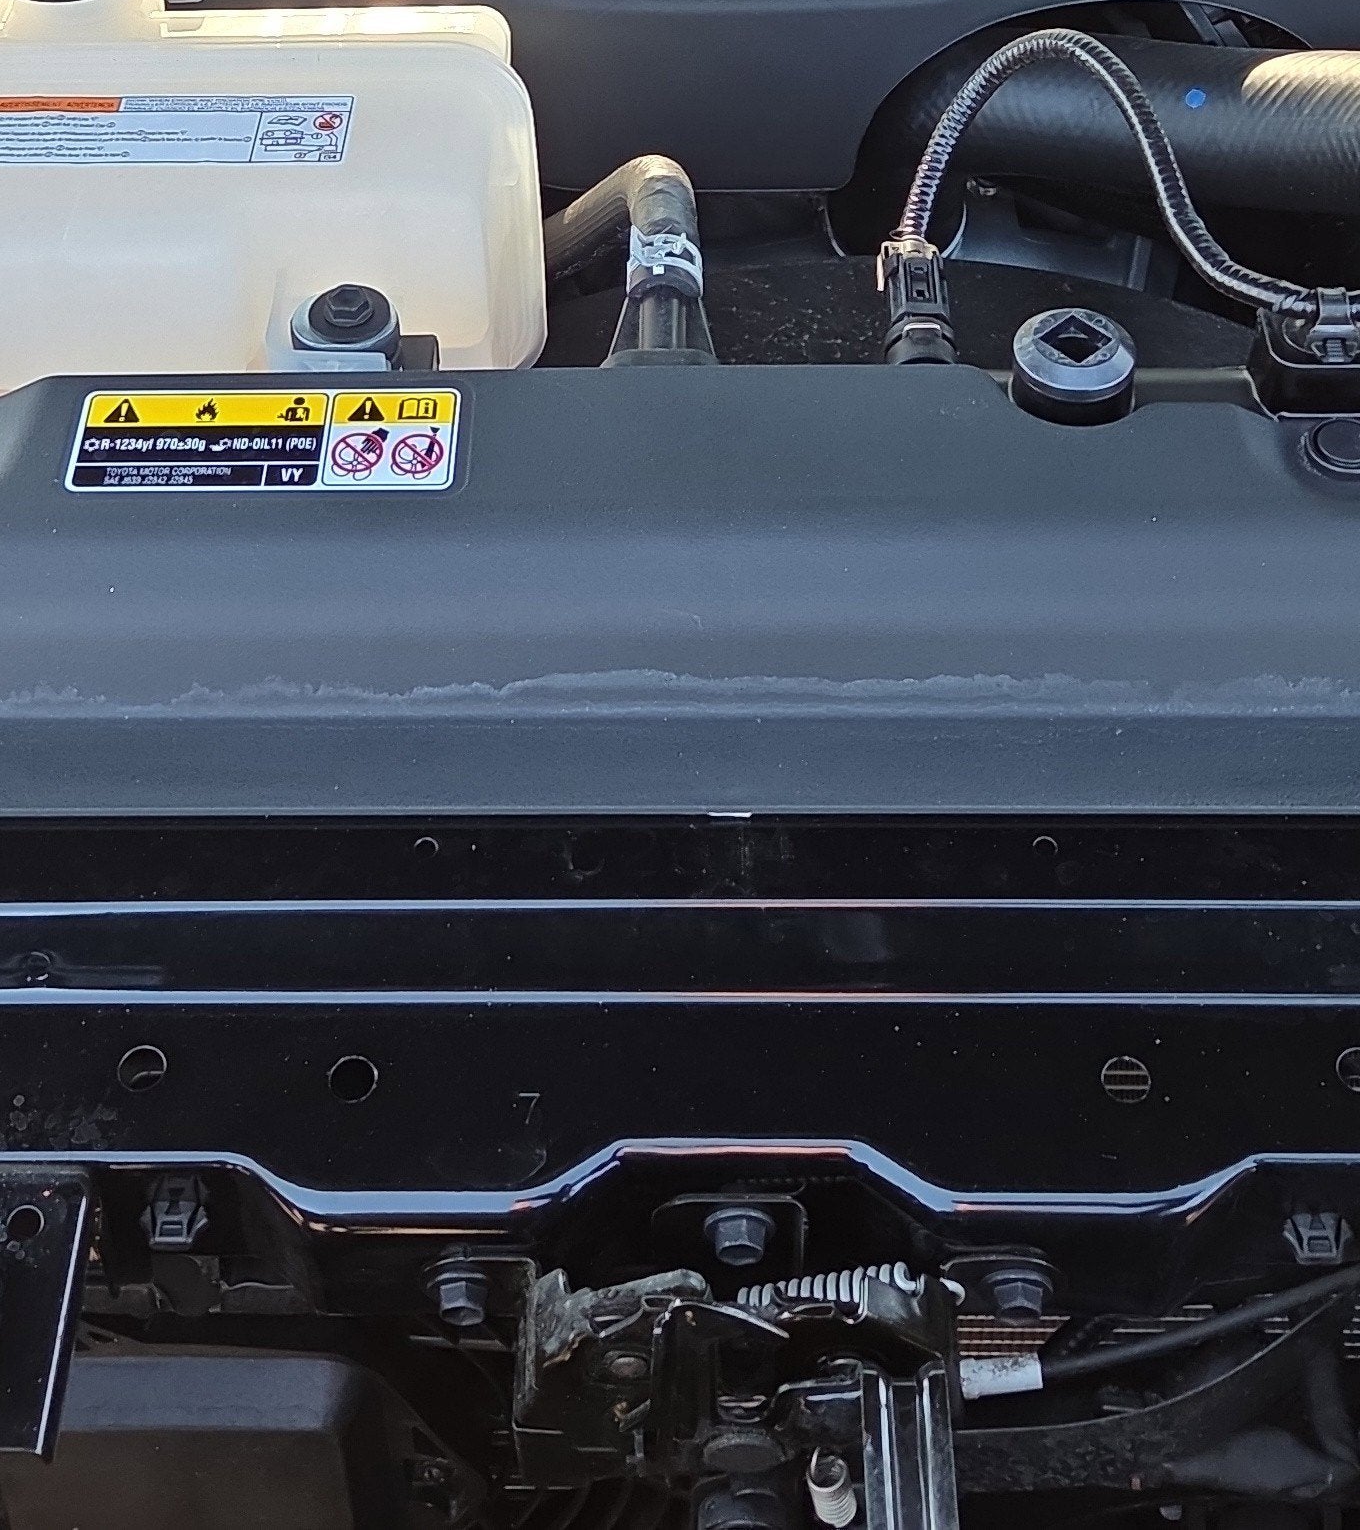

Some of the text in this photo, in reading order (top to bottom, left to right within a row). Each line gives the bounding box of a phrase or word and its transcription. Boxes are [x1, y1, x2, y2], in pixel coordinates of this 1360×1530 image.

[100, 438, 154, 452] R-1234yf
[156, 437, 206, 451] 970±30g
[285, 437, 317, 451] (POE)
[107, 467, 138, 476] TOYOTA
[281, 468, 304, 482] VY
